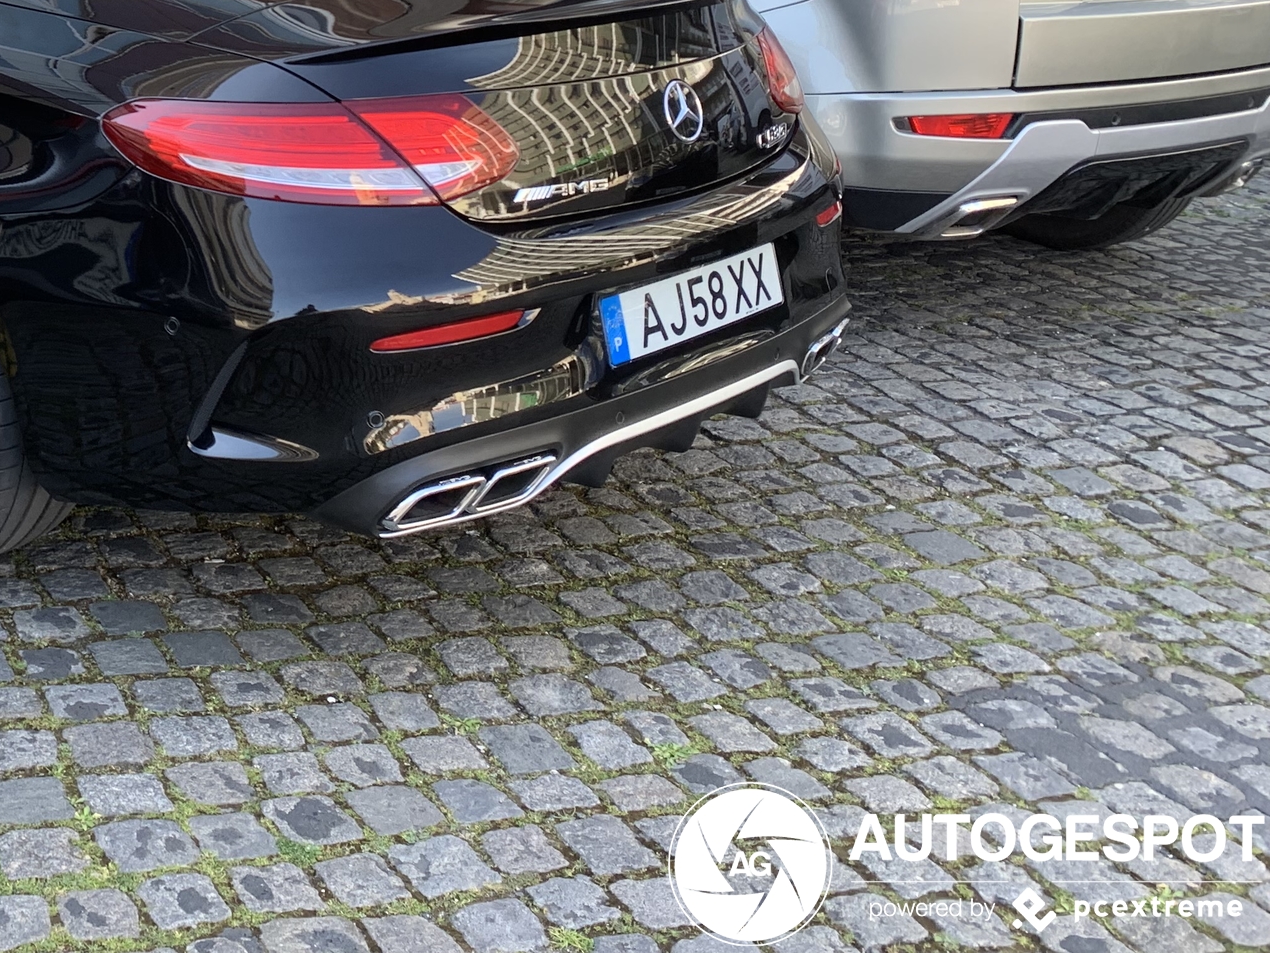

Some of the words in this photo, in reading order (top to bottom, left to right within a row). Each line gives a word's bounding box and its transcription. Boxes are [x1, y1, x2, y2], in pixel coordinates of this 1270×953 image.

[544, 178, 609, 198] AMG
[642, 252, 773, 349] AJ58XX
[614, 337, 623, 353] P
